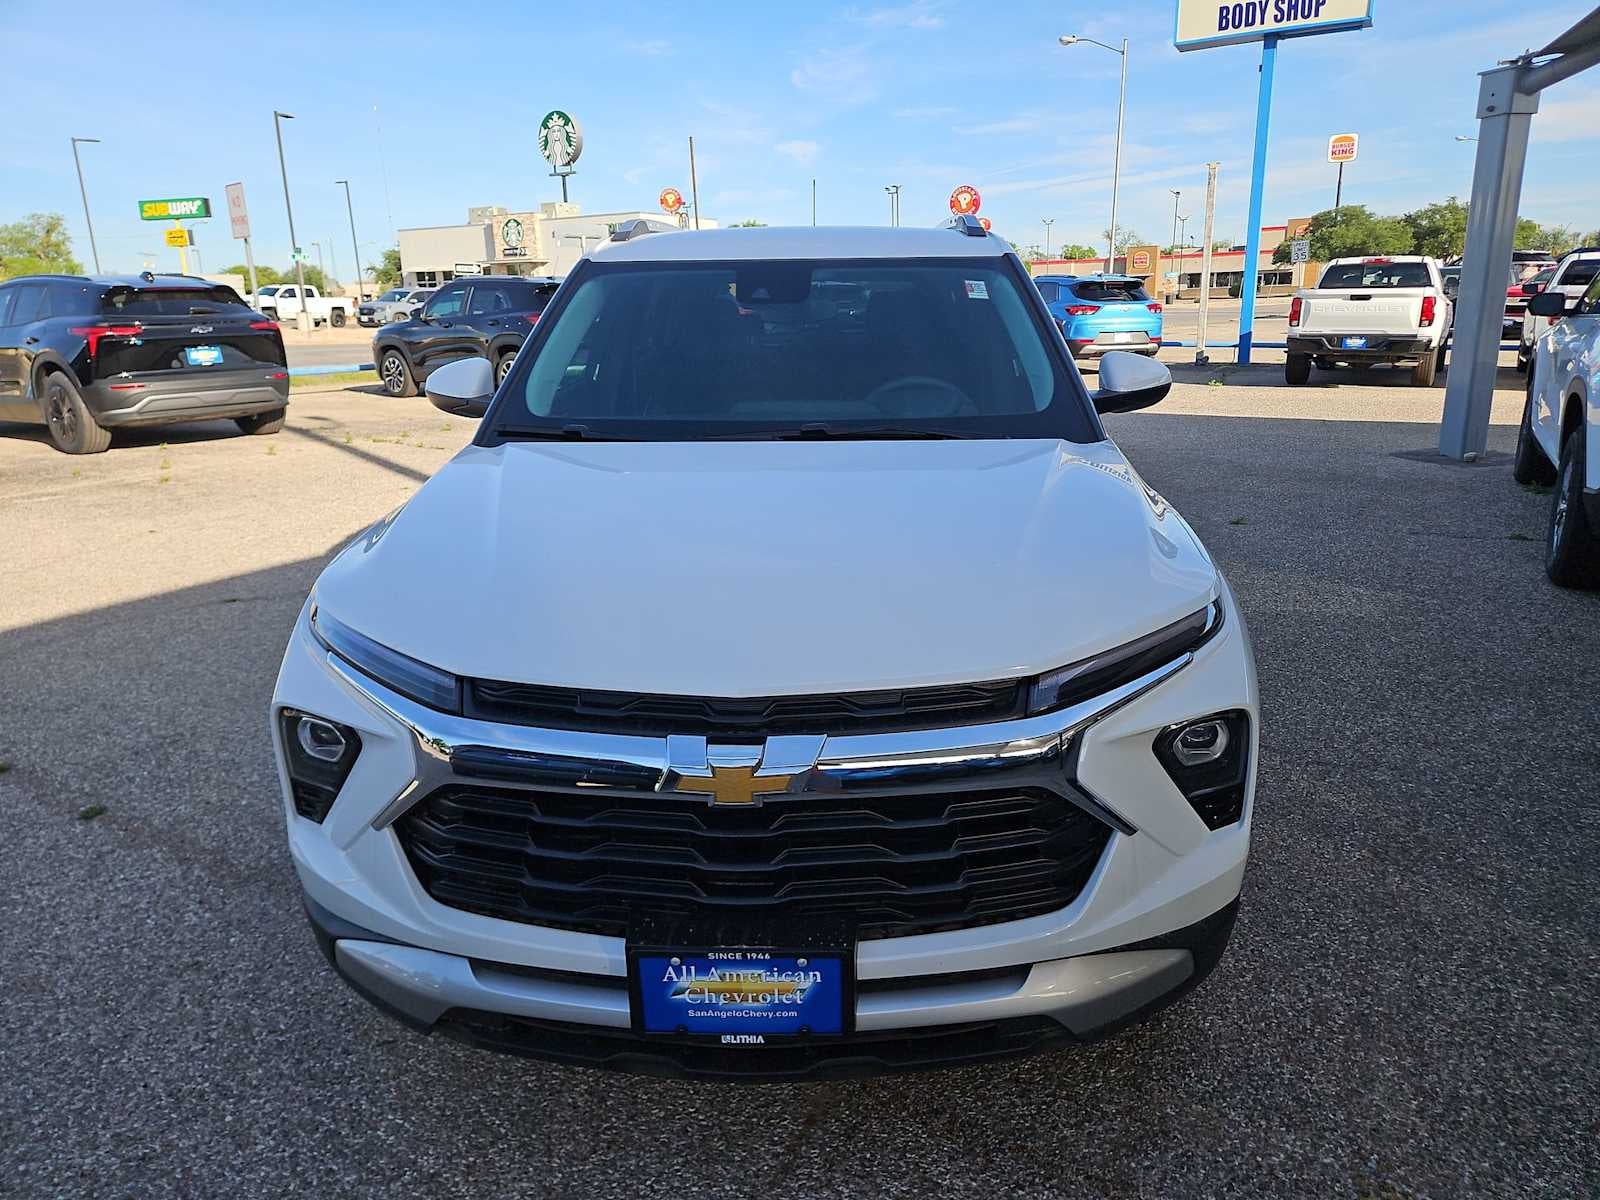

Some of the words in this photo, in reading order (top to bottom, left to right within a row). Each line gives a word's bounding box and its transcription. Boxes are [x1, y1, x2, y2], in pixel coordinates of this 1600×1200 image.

[1218, 0, 1269, 31] BODY
[1273, 0, 1326, 23] SHOP
[1331, 148, 1354, 156] KING
[143, 200, 202, 217] SUBWAY
[1293, 251, 1307, 260] 35
[1312, 302, 1409, 313] CHEVROLET
[707, 952, 743, 960] SINCE
[746, 952, 771, 960] 1946
[662, 965, 696, 982] All
[707, 966, 823, 983] American
[685, 987, 804, 1005] Chevrolet
[687, 1009, 798, 1019] SanAngeloChevy.com
[731, 1034, 765, 1044] LITHIA
